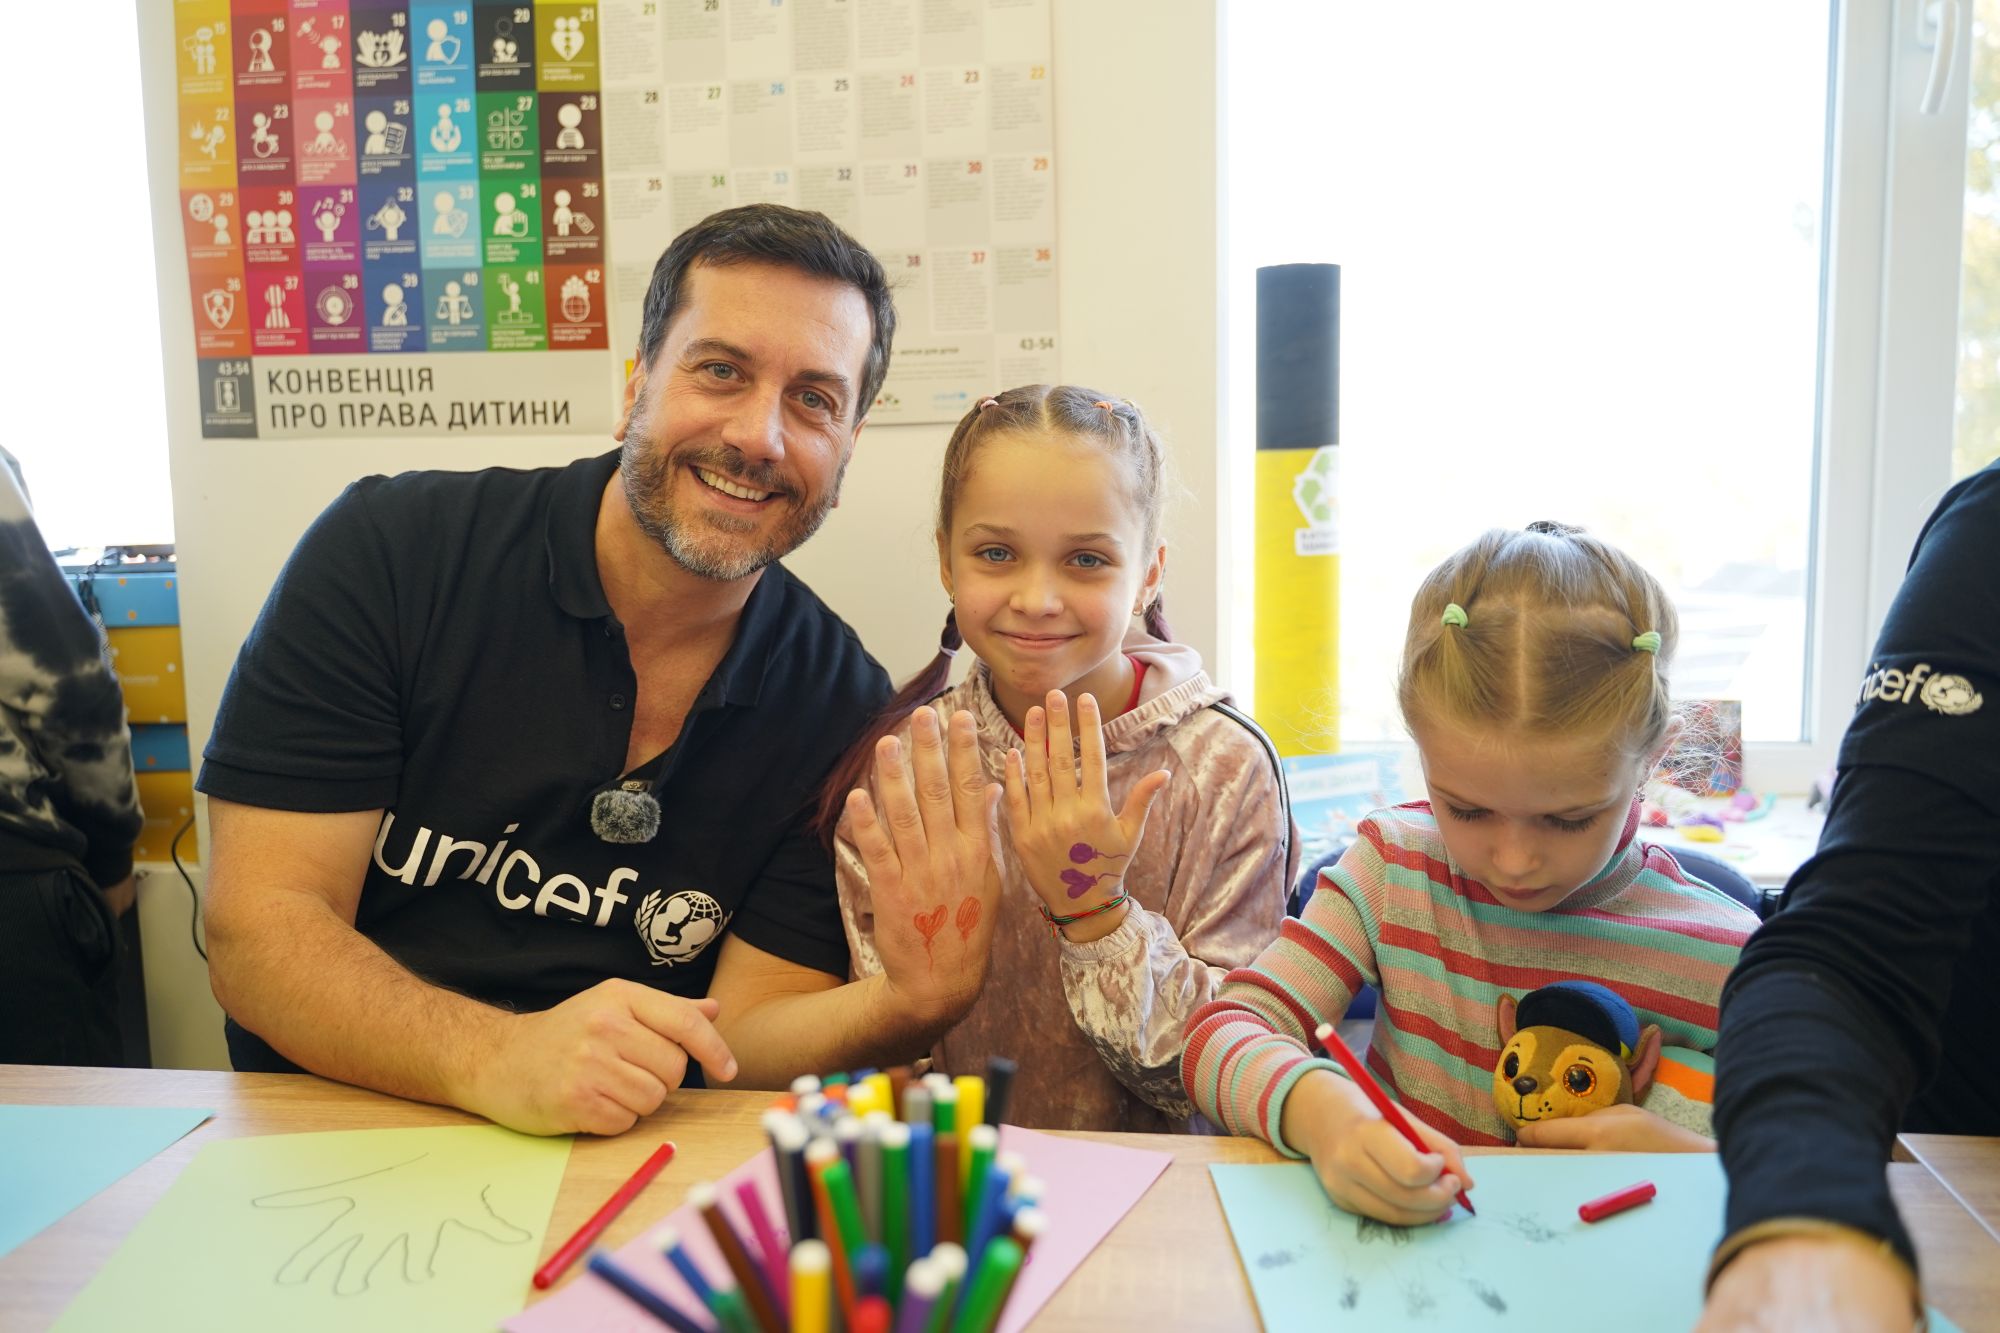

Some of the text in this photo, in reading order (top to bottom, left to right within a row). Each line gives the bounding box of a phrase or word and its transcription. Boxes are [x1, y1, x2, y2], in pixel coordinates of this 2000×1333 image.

[514, 8, 530, 23] 20
[581, 7, 595, 22] 21
[643, 3, 657, 16] 21
[332, 15, 345, 30] 17
[392, 12, 406, 27] 18
[454, 10, 468, 25] 19
[272, 17, 285, 33] 16
[964, 70, 980, 84] 23
[1030, 66, 1046, 80] 22
[834, 79, 850, 93] 25
[900, 74, 916, 88] 24
[708, 86, 722, 100] 27
[770, 82, 785, 96] 26
[518, 96, 533, 111] 27
[581, 96, 597, 111] 28
[645, 90, 659, 104] 28
[274, 105, 289, 119] 23
[335, 103, 349, 117] 24
[394, 101, 410, 116] 25
[456, 99, 471, 113] 26
[216, 108, 230, 122] 22
[967, 160, 982, 174] 30
[1033, 156, 1048, 171] 29
[773, 171, 789, 185] 33
[837, 168, 852, 182] 32
[904, 164, 918, 178] 31
[648, 177, 663, 191] 35
[711, 174, 726, 188] 34
[339, 189, 354, 204] 31
[398, 188, 414, 202] 32
[459, 186, 474, 200] 33
[520, 184, 536, 199] 34
[582, 183, 599, 198] 35
[219, 193, 234, 207] 29
[278, 191, 293, 206] 30
[906, 254, 922, 268] 38
[970, 251, 986, 265] 37
[1035, 248, 1051, 262] 36
[285, 276, 299, 291] 37
[343, 274, 358, 290] 38
[403, 274, 418, 288] 39
[463, 272, 478, 287] 40
[525, 270, 540, 285] 41
[585, 269, 600, 284] 42
[226, 278, 241, 293] 36
[1020, 336, 1054, 351] 43-54
[218, 361, 250, 376] 43-54
[267, 367, 434, 398] КОНВЕНЦІЯ
[271, 400, 571, 431] ПРО ПРАВА ДИТИНИ
[373, 811, 640, 928] unicef
